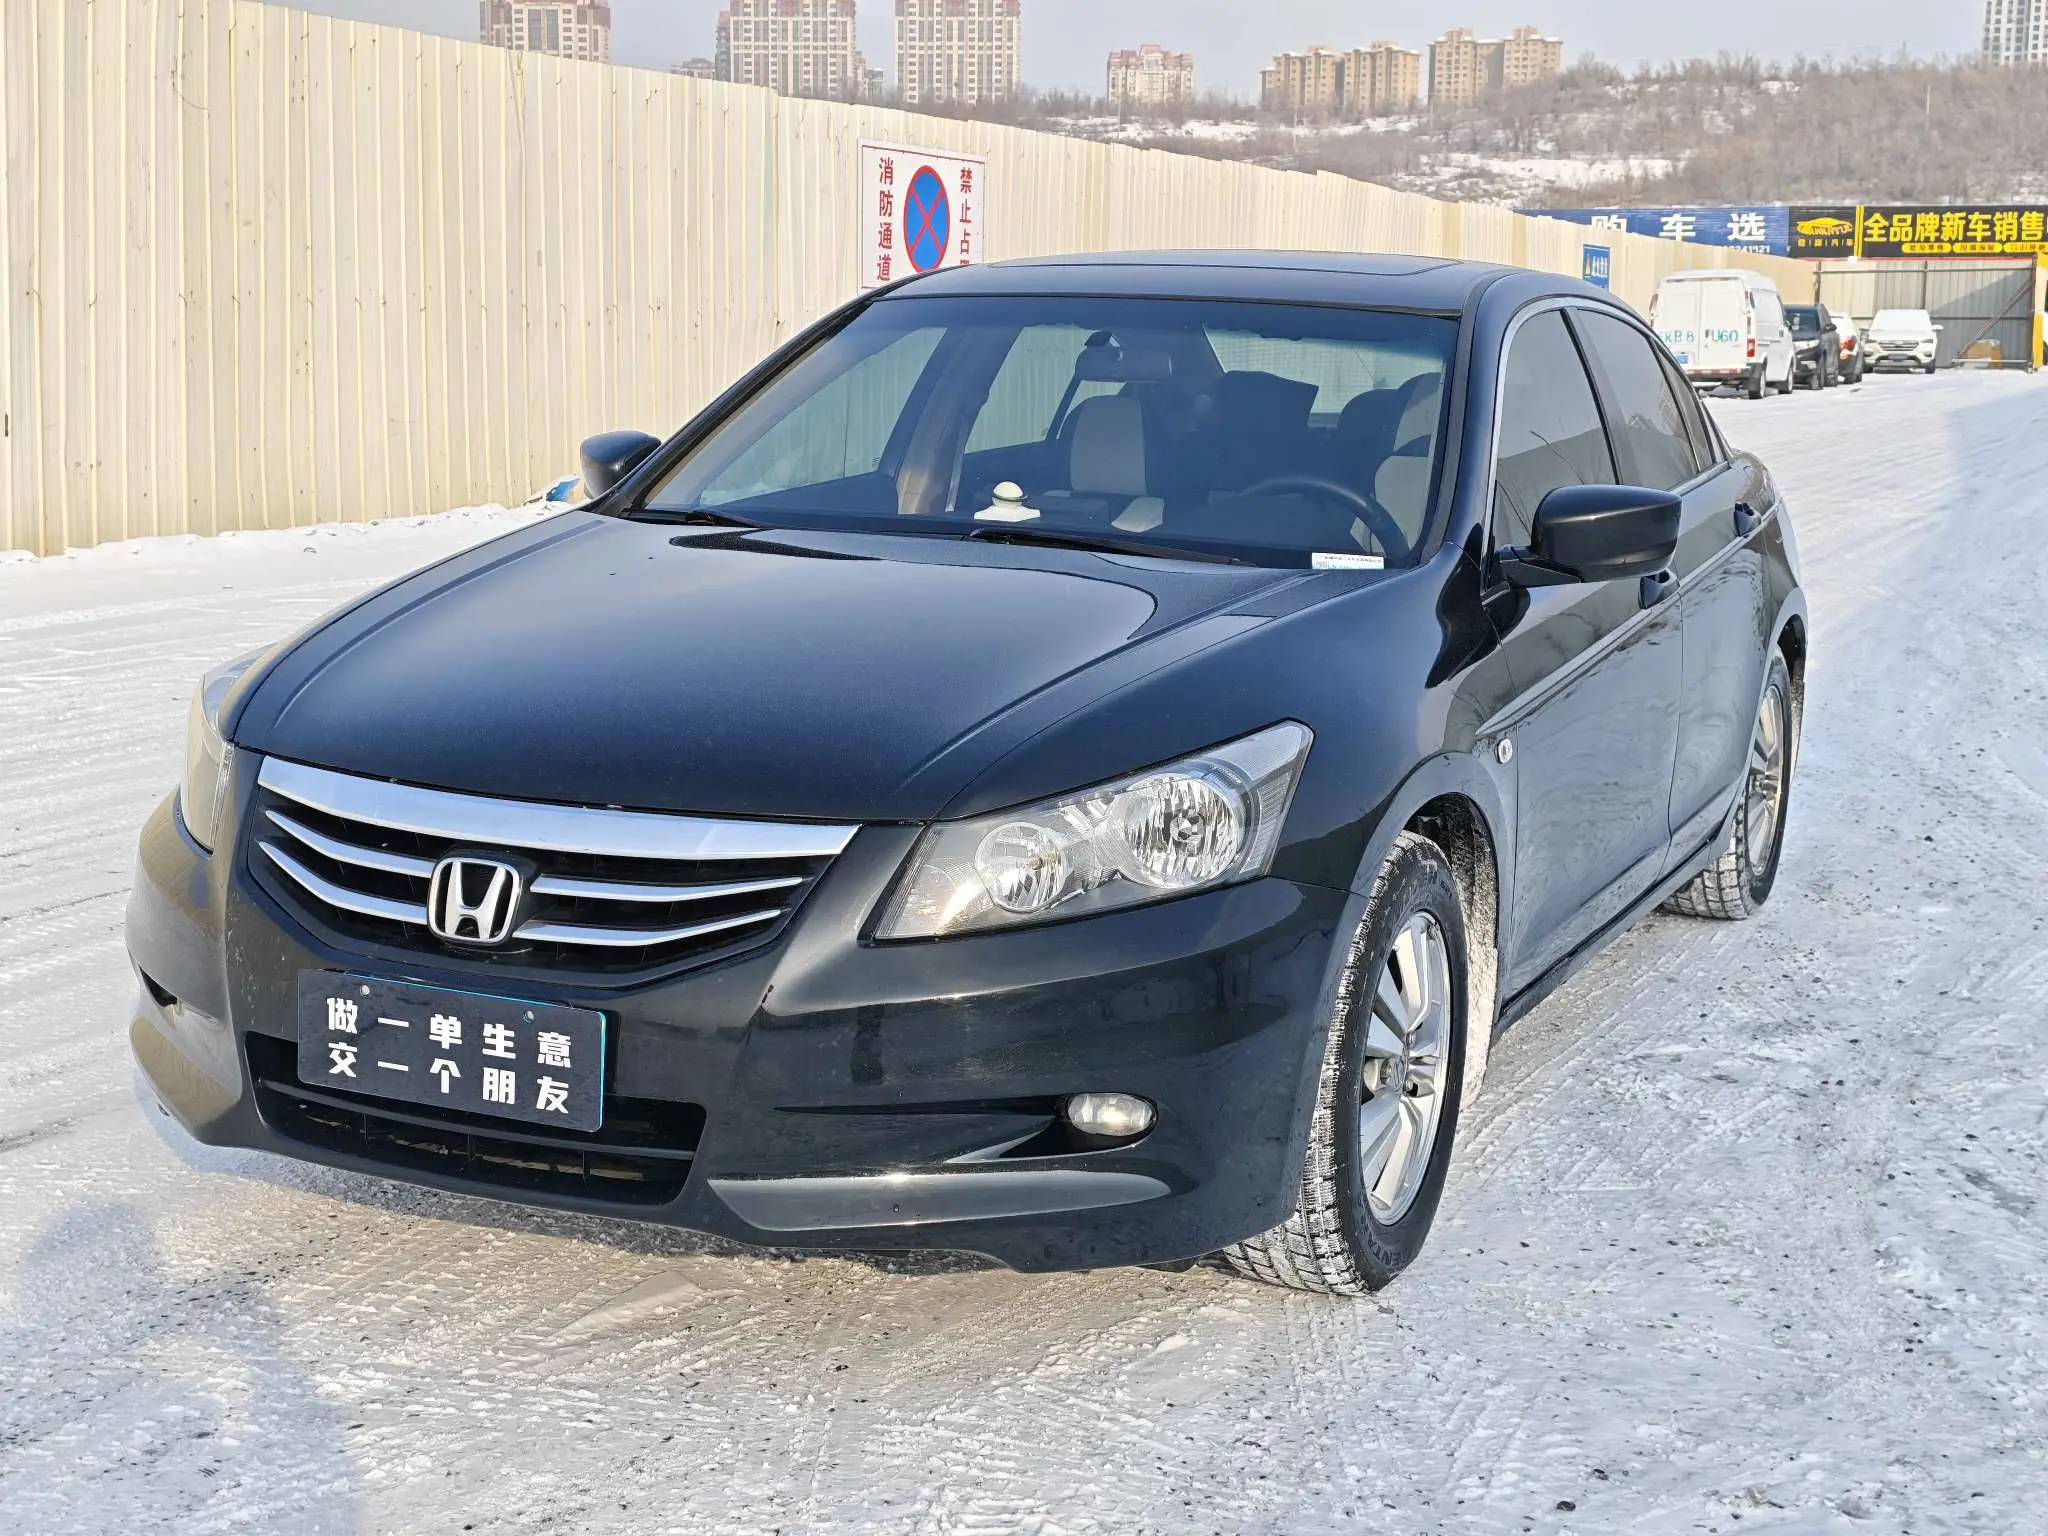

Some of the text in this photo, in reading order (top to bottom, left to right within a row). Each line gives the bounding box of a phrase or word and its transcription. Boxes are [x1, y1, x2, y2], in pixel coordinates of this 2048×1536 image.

[877, 156, 894, 281] 消防通道
[1537, 212, 1767, 241] 购车选
[1863, 211, 2048, 242] 全品牌新车销售
[326, 997, 572, 1069] 做一单生意
[327, 1041, 570, 1114] 交一个朋友
